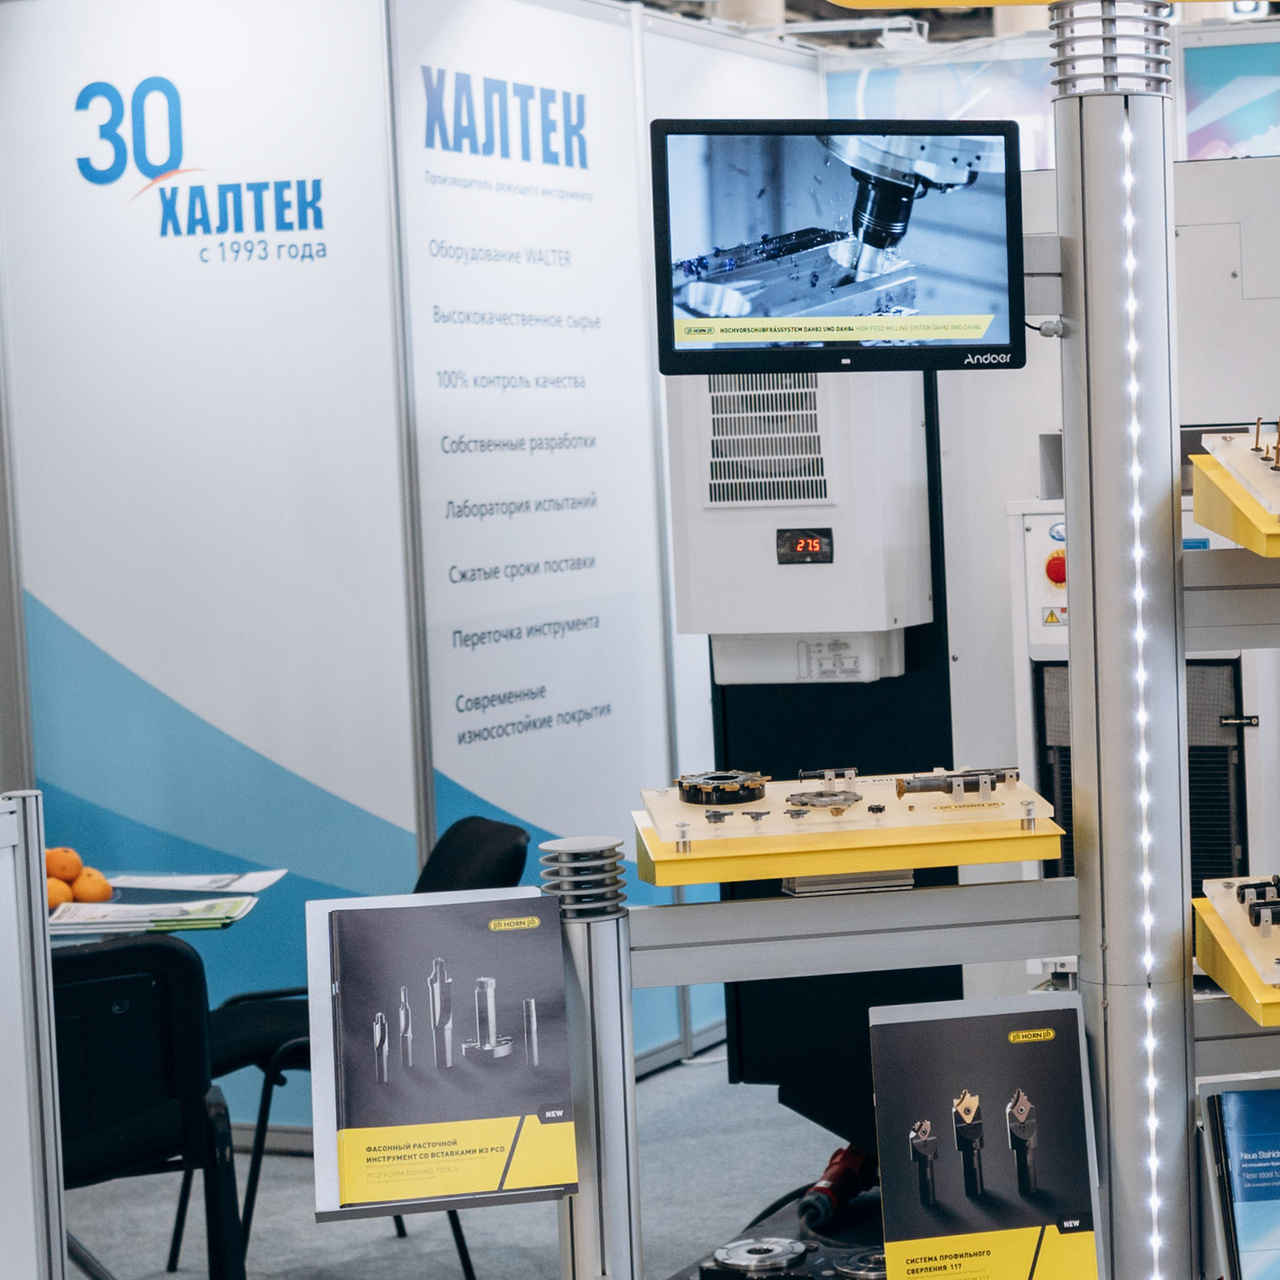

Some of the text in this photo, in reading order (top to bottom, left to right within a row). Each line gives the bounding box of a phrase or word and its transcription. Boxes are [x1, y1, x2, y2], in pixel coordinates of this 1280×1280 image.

[421, 65, 589, 169] ХАЛТЕК
[75, 76, 184, 184] 30
[425, 170, 492, 190] Производитель
[160, 178, 324, 237] ХАЛТЕК
[200, 240, 327, 263] с 1993 года
[429, 239, 572, 267] Оборудование WALTER
[433, 305, 601, 330] Высококачественное сырье
[964, 353, 1011, 364] Andoer
[437, 370, 586, 392] 100% контроль качества
[441, 432, 596, 455] Собственные разработки
[445, 491, 598, 521] Лаборатория испытаний
[449, 555, 595, 583] Сжатые сроки поставки
[453, 614, 600, 651] Переточка инструмента
[456, 684, 546, 714] Современные
[458, 702, 612, 745] износостойкие покрытия
[545, 1110, 563, 1118] NEW
[366, 1138, 458, 1153] ФАСОННЫЙ РАСТОЧНОЙ
[366, 1154, 417, 1163] ИНСТРУМЕНТ
[431, 1149, 476, 1158] ВСТАВКАМИ
[1240, 1152, 1257, 1160] Neue
[1064, 1220, 1080, 1228] NEW
[906, 1250, 991, 1264] СИСТЕМА ПРОФИЛЬНОГО
[907, 1265, 947, 1275] СВЕРЛЕНИЯ
